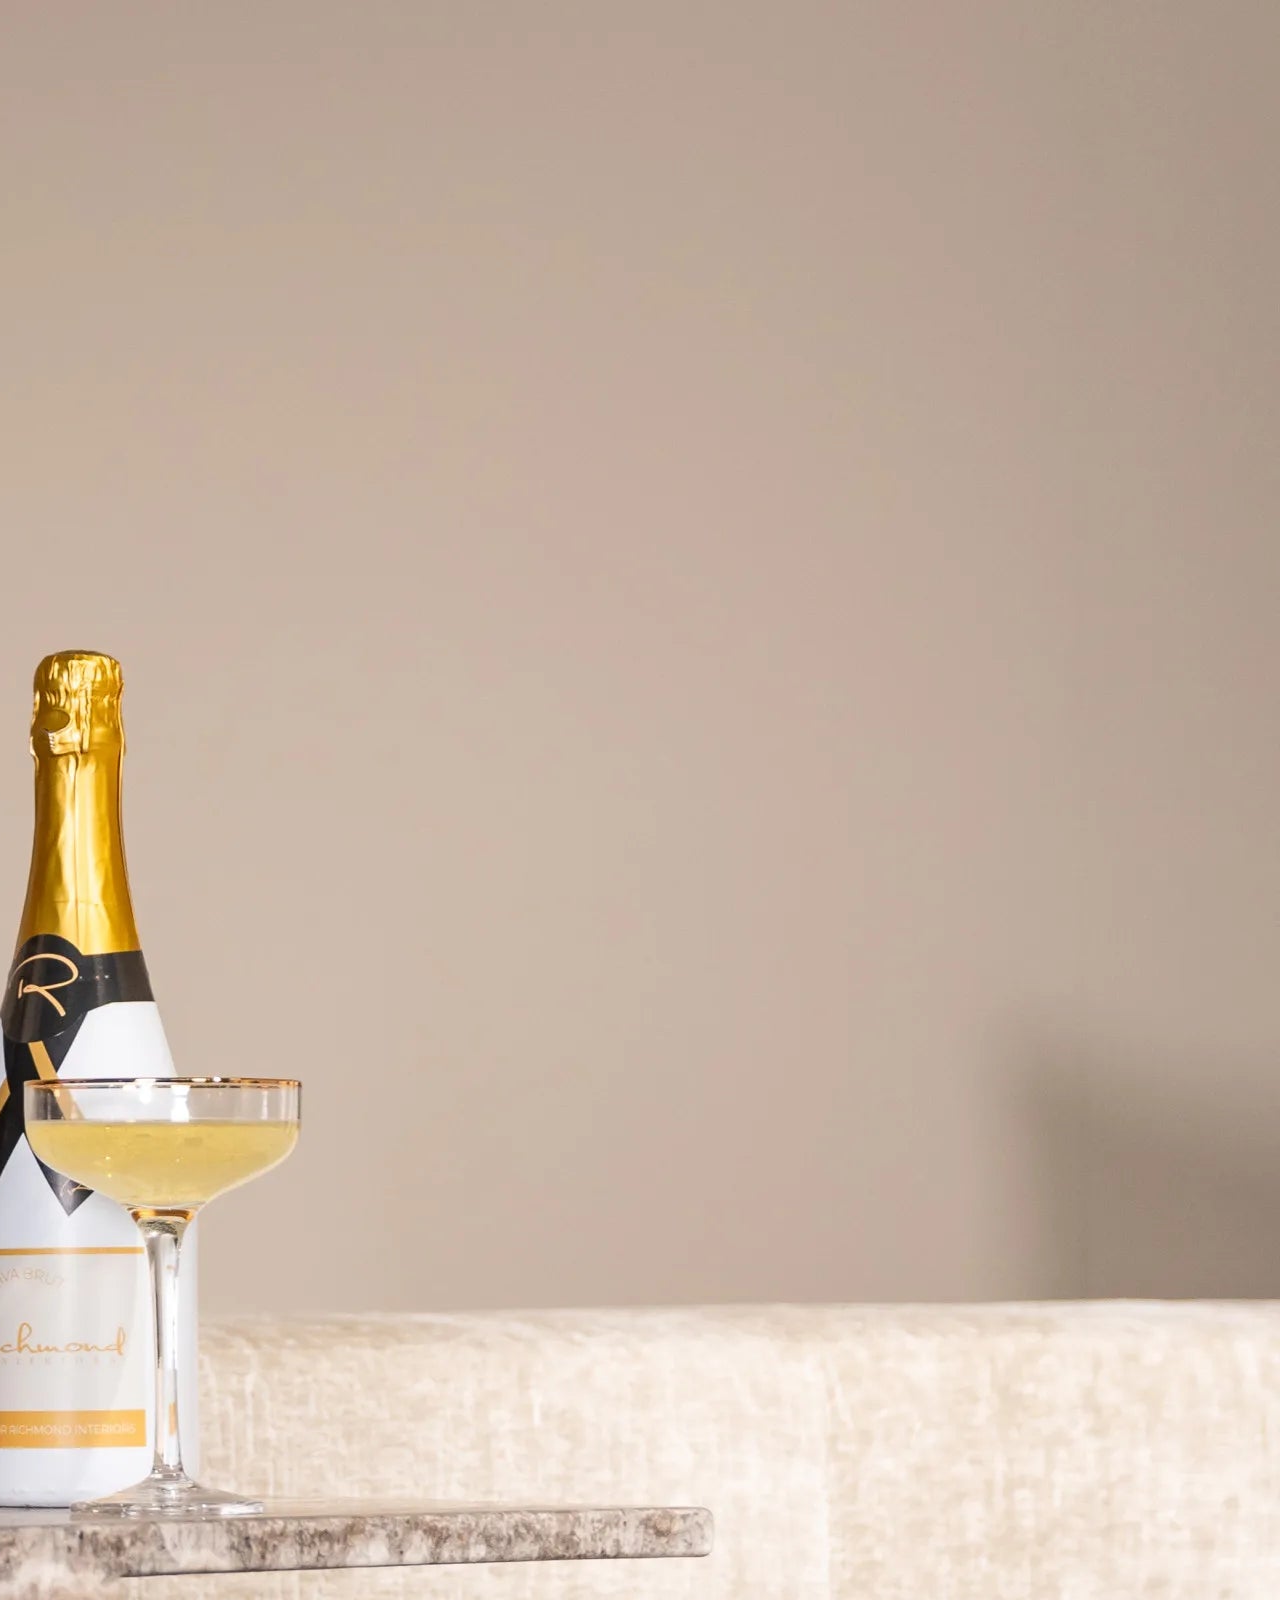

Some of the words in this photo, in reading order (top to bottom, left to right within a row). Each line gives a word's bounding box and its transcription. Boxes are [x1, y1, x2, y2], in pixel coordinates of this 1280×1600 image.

[11, 952, 79, 1018] R
[23, 1267, 65, 1289] BRUT
[8, 1424, 72, 1435] RICHMOND
[74, 1423, 137, 1435] INTERIORS
